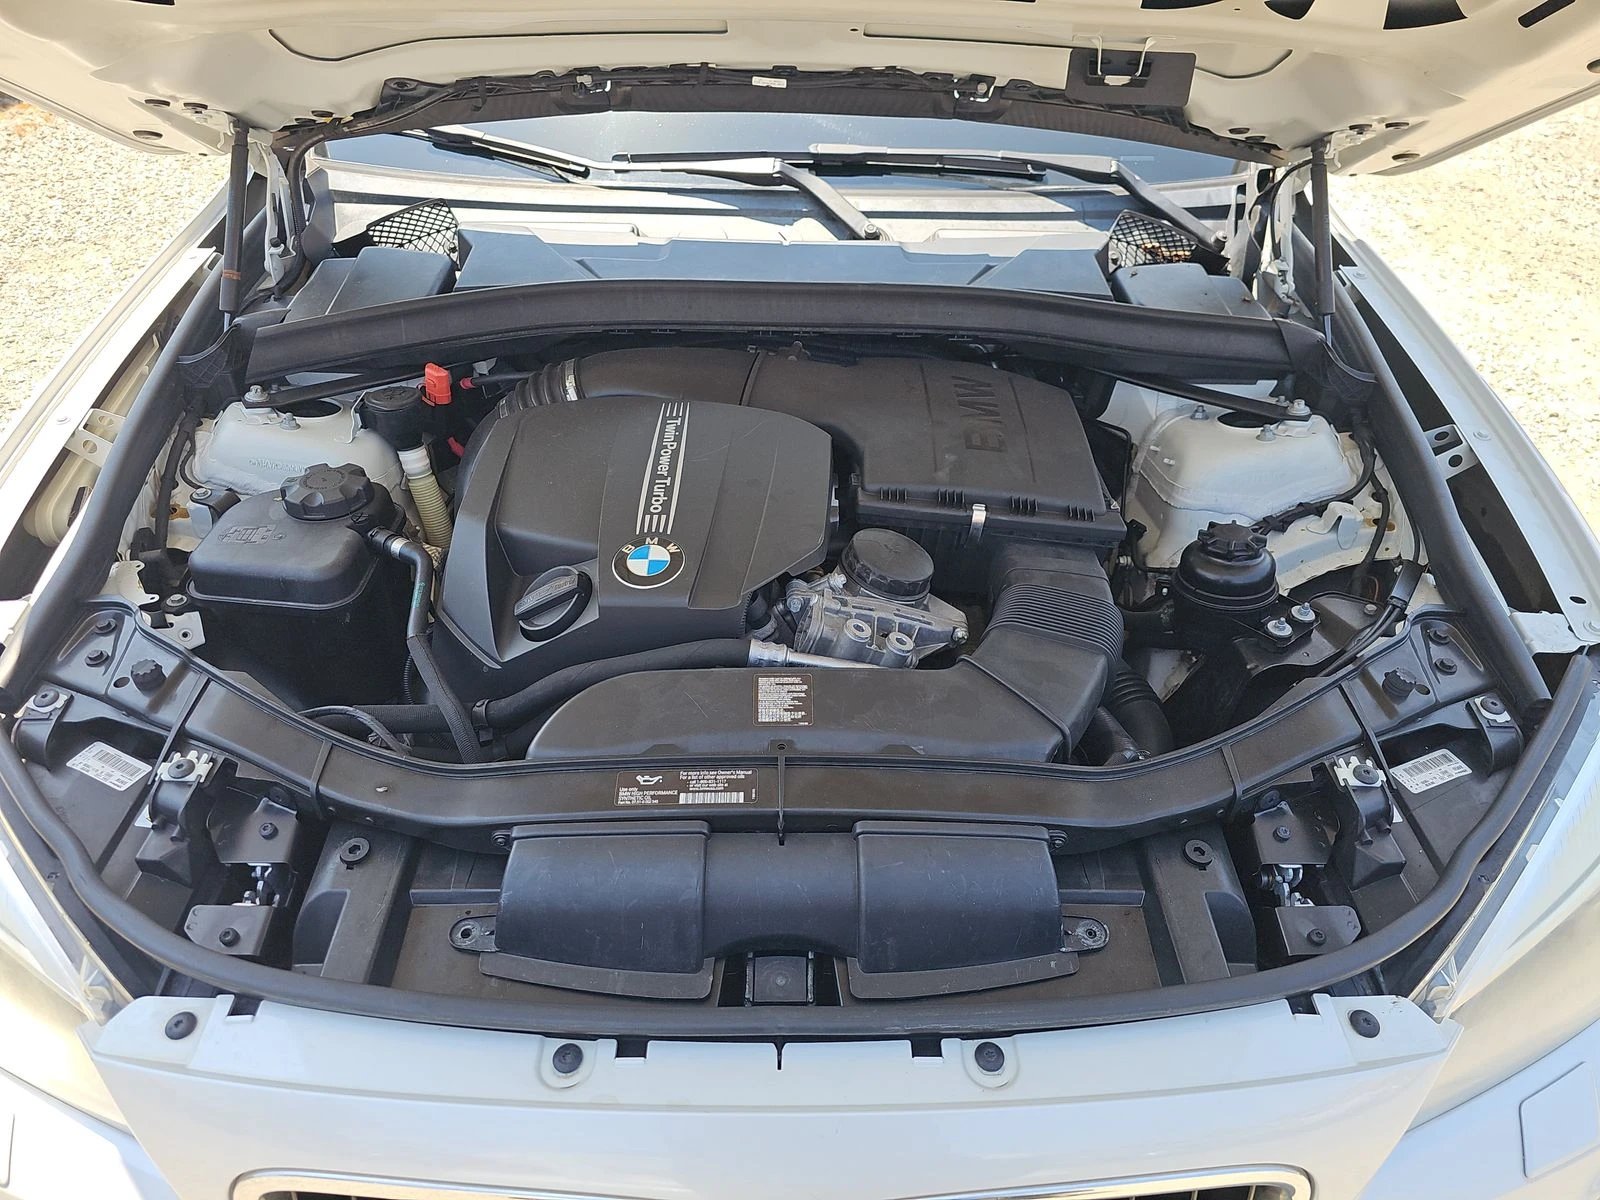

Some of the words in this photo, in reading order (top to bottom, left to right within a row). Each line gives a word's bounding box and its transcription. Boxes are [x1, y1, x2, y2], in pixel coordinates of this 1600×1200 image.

[951, 375, 1007, 453] BMW
[656, 416, 682, 477] TwinPower
[649, 477, 672, 514] Turbo
[622, 536, 681, 554] BMW
